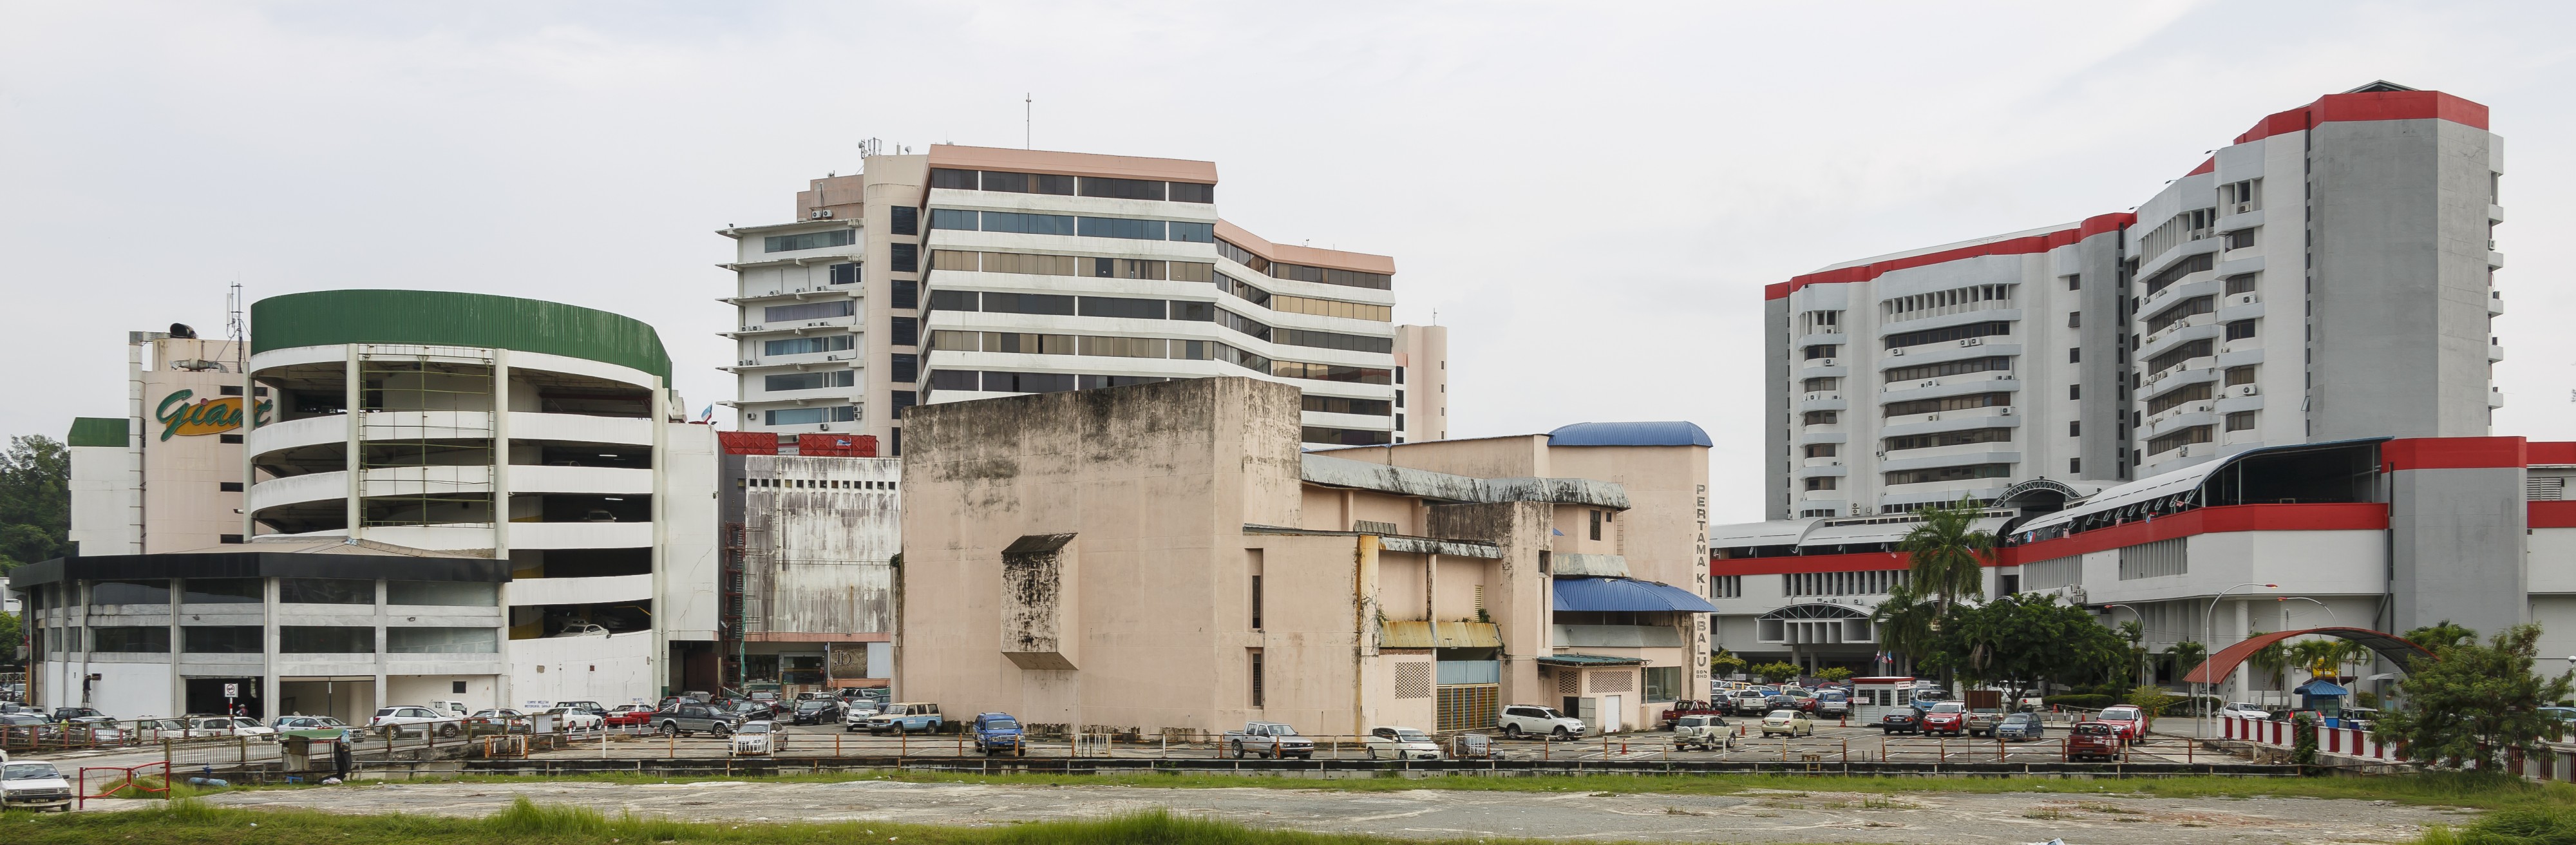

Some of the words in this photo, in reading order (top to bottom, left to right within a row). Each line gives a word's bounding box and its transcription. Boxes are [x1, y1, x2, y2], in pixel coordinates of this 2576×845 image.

[156, 389, 273, 442] Giant
[1696, 484, 1706, 567] PERTAMA
[1696, 573, 1707, 667] KIABALU
[835, 650, 852, 666] JD
